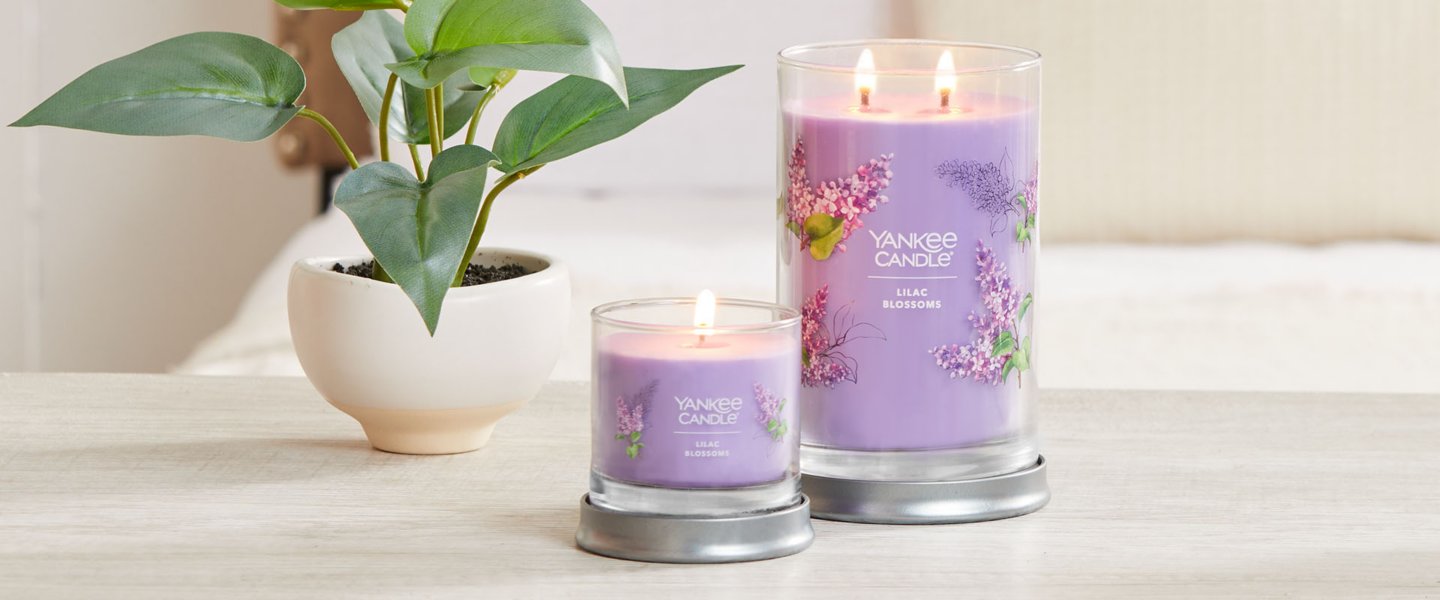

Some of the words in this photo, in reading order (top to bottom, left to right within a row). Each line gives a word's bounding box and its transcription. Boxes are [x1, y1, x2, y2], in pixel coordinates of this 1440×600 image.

[896, 288, 928, 297] LILAC
[882, 300, 942, 309] BLOSSOMS
[695, 440, 720, 448] LILAC
